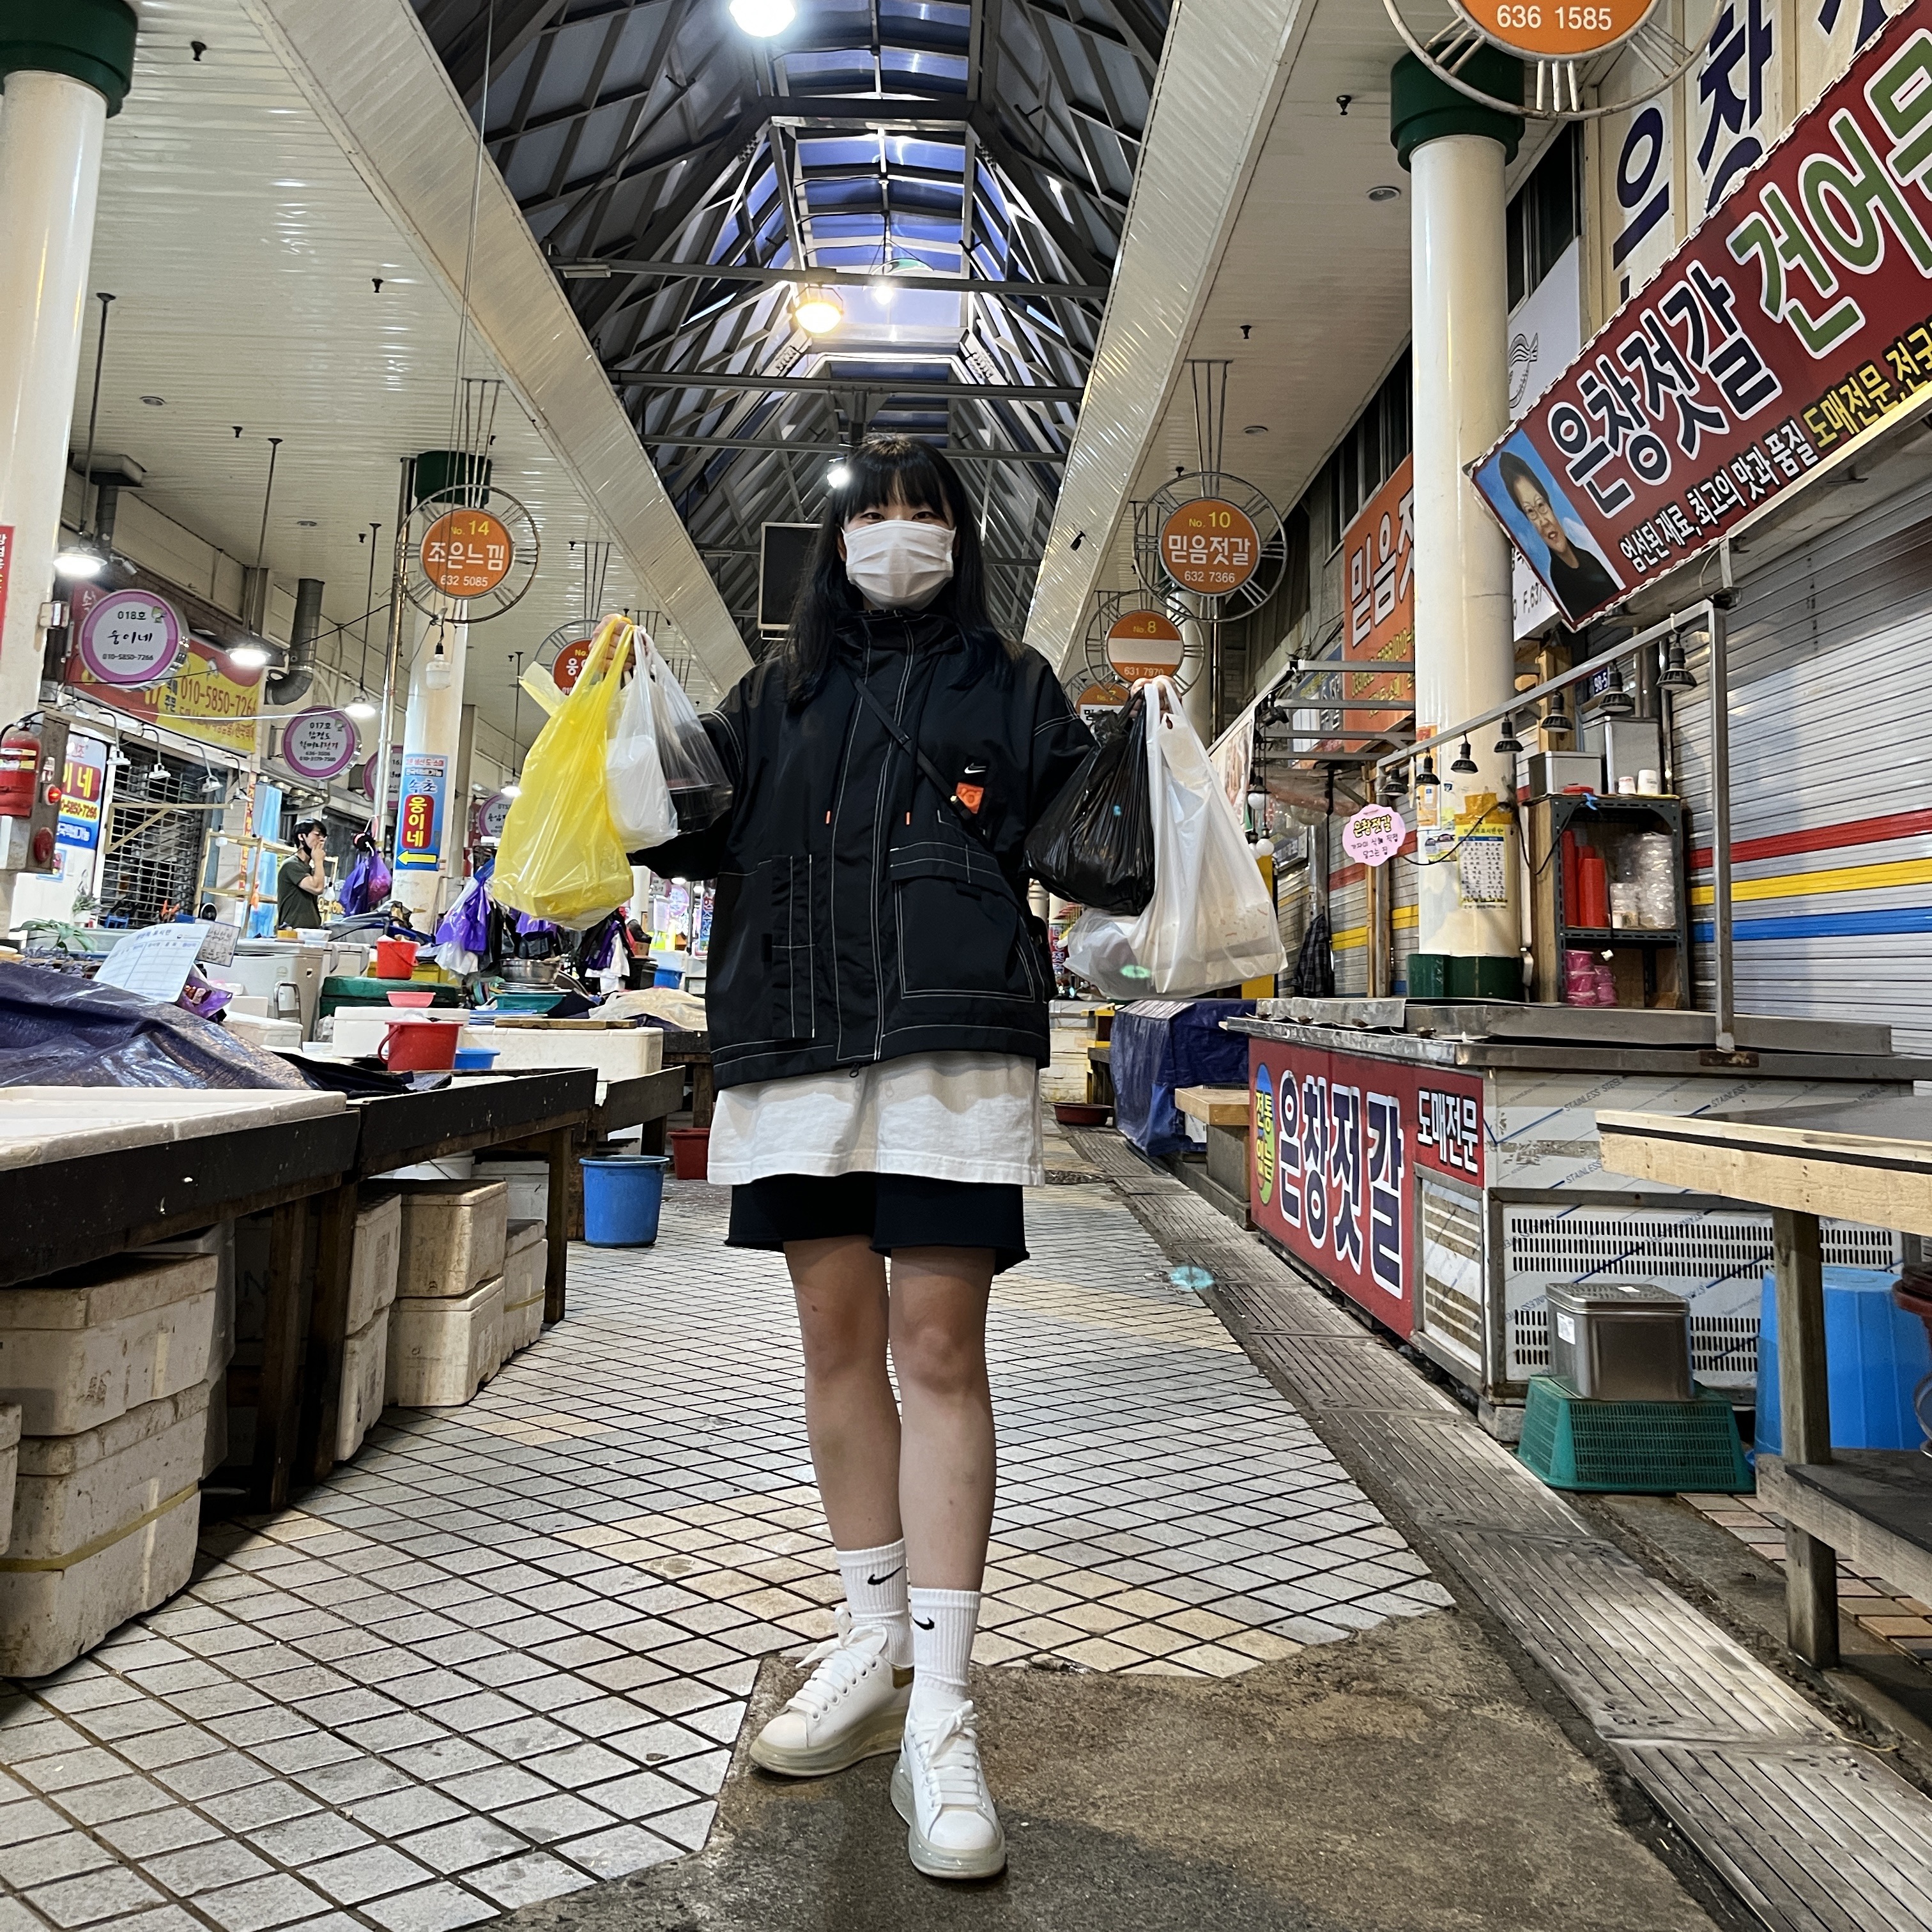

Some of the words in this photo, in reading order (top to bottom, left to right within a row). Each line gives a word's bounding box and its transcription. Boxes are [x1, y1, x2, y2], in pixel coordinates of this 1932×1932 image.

[1496, 4, 1542, 29] 636
[1554, 6, 1612, 31] 1585
[1547, 259, 1782, 519] 은창젓갈
[1620, 521, 1669, 573] 엄선된
[1687, 469, 1746, 525] 최고의
[1731, 445, 1780, 500] 맛과
[1765, 420, 1819, 478] 품질
[469, 520, 489, 535] 14
[1209, 511, 1230, 528] 10
[427, 542, 505, 571] 조은느낌
[1169, 535, 1250, 565] 믿음젓갈
[440, 575, 459, 585] 632
[463, 576, 488, 586] 5085
[1184, 571, 1204, 582] 632
[1209, 571, 1236, 583] 7366
[118, 611, 146, 620] 018호
[1147, 621, 1156, 634] 8
[107, 630, 153, 645] 웅이네
[1124, 666, 1139, 675] 631
[409, 779, 436, 793] 속초
[406, 796, 427, 847] 웅이네
[1279, 1070, 1404, 1300] 은창젓갈
[1418, 1089, 1479, 1174] 도매전문
